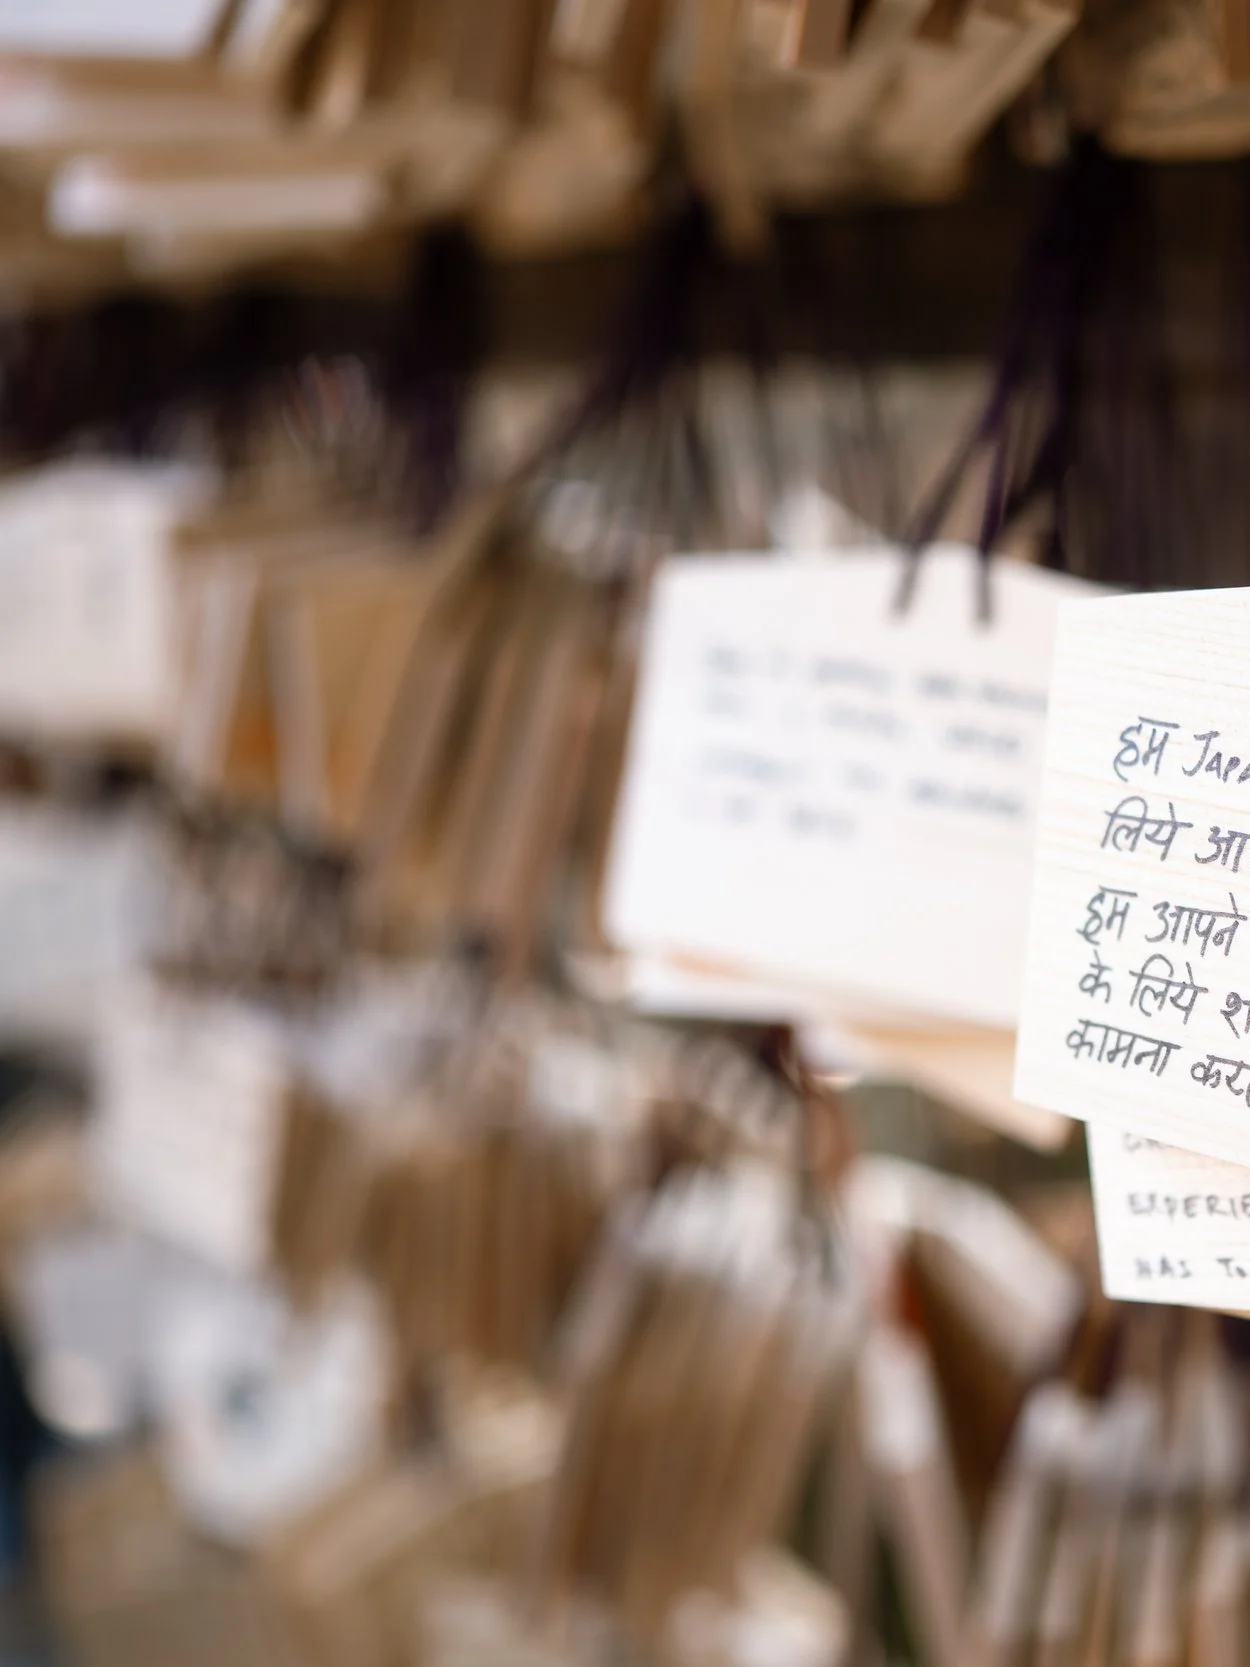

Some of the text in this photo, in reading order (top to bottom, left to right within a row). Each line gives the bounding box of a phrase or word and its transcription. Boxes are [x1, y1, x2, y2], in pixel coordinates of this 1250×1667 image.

[1113, 716, 1180, 782] हम
[1101, 796, 1193, 861] लिये
[1077, 886, 1138, 945] हम
[1079, 950, 1111, 1003] के
[1129, 953, 1209, 1025] लिये
[1066, 1019, 1182, 1076] कामना
